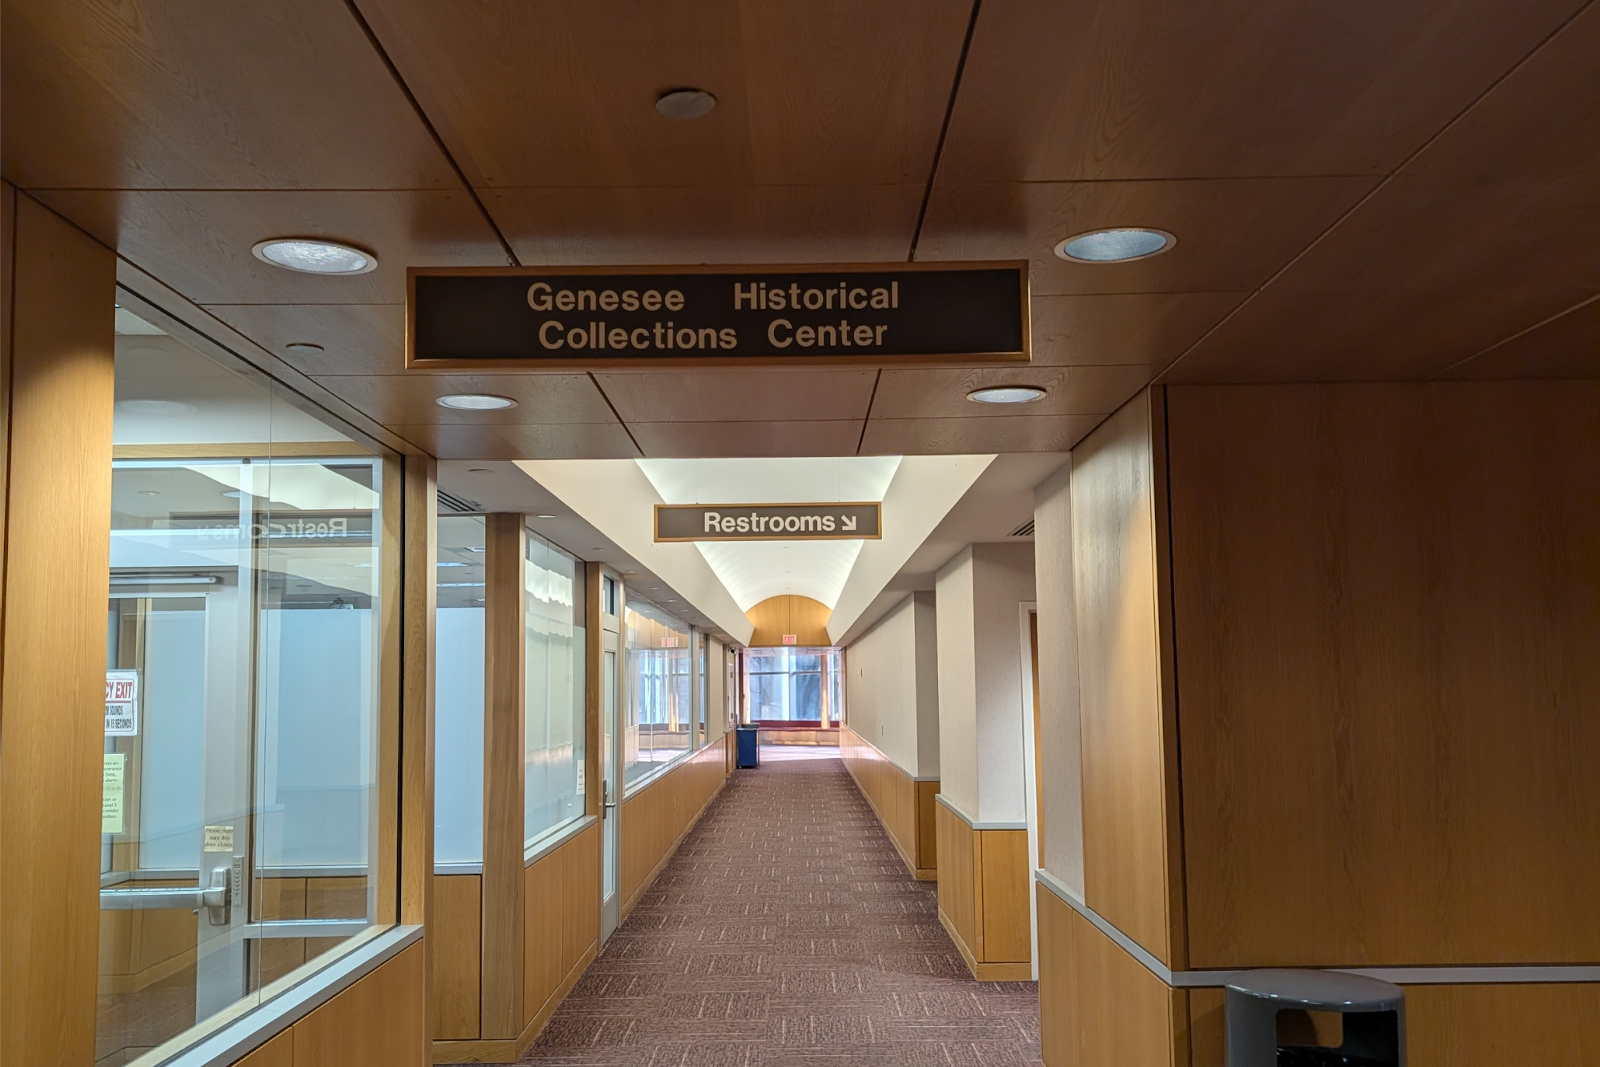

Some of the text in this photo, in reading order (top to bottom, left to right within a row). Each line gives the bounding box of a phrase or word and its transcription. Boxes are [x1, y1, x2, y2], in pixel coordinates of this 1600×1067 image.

[527, 281, 898, 311] Genesee Historical
[538, 319, 888, 350] Collections Center
[704, 512, 836, 532] Restrooms
[115, 681, 133, 699] EXIT
[114, 718, 132, 729] SECONDS
